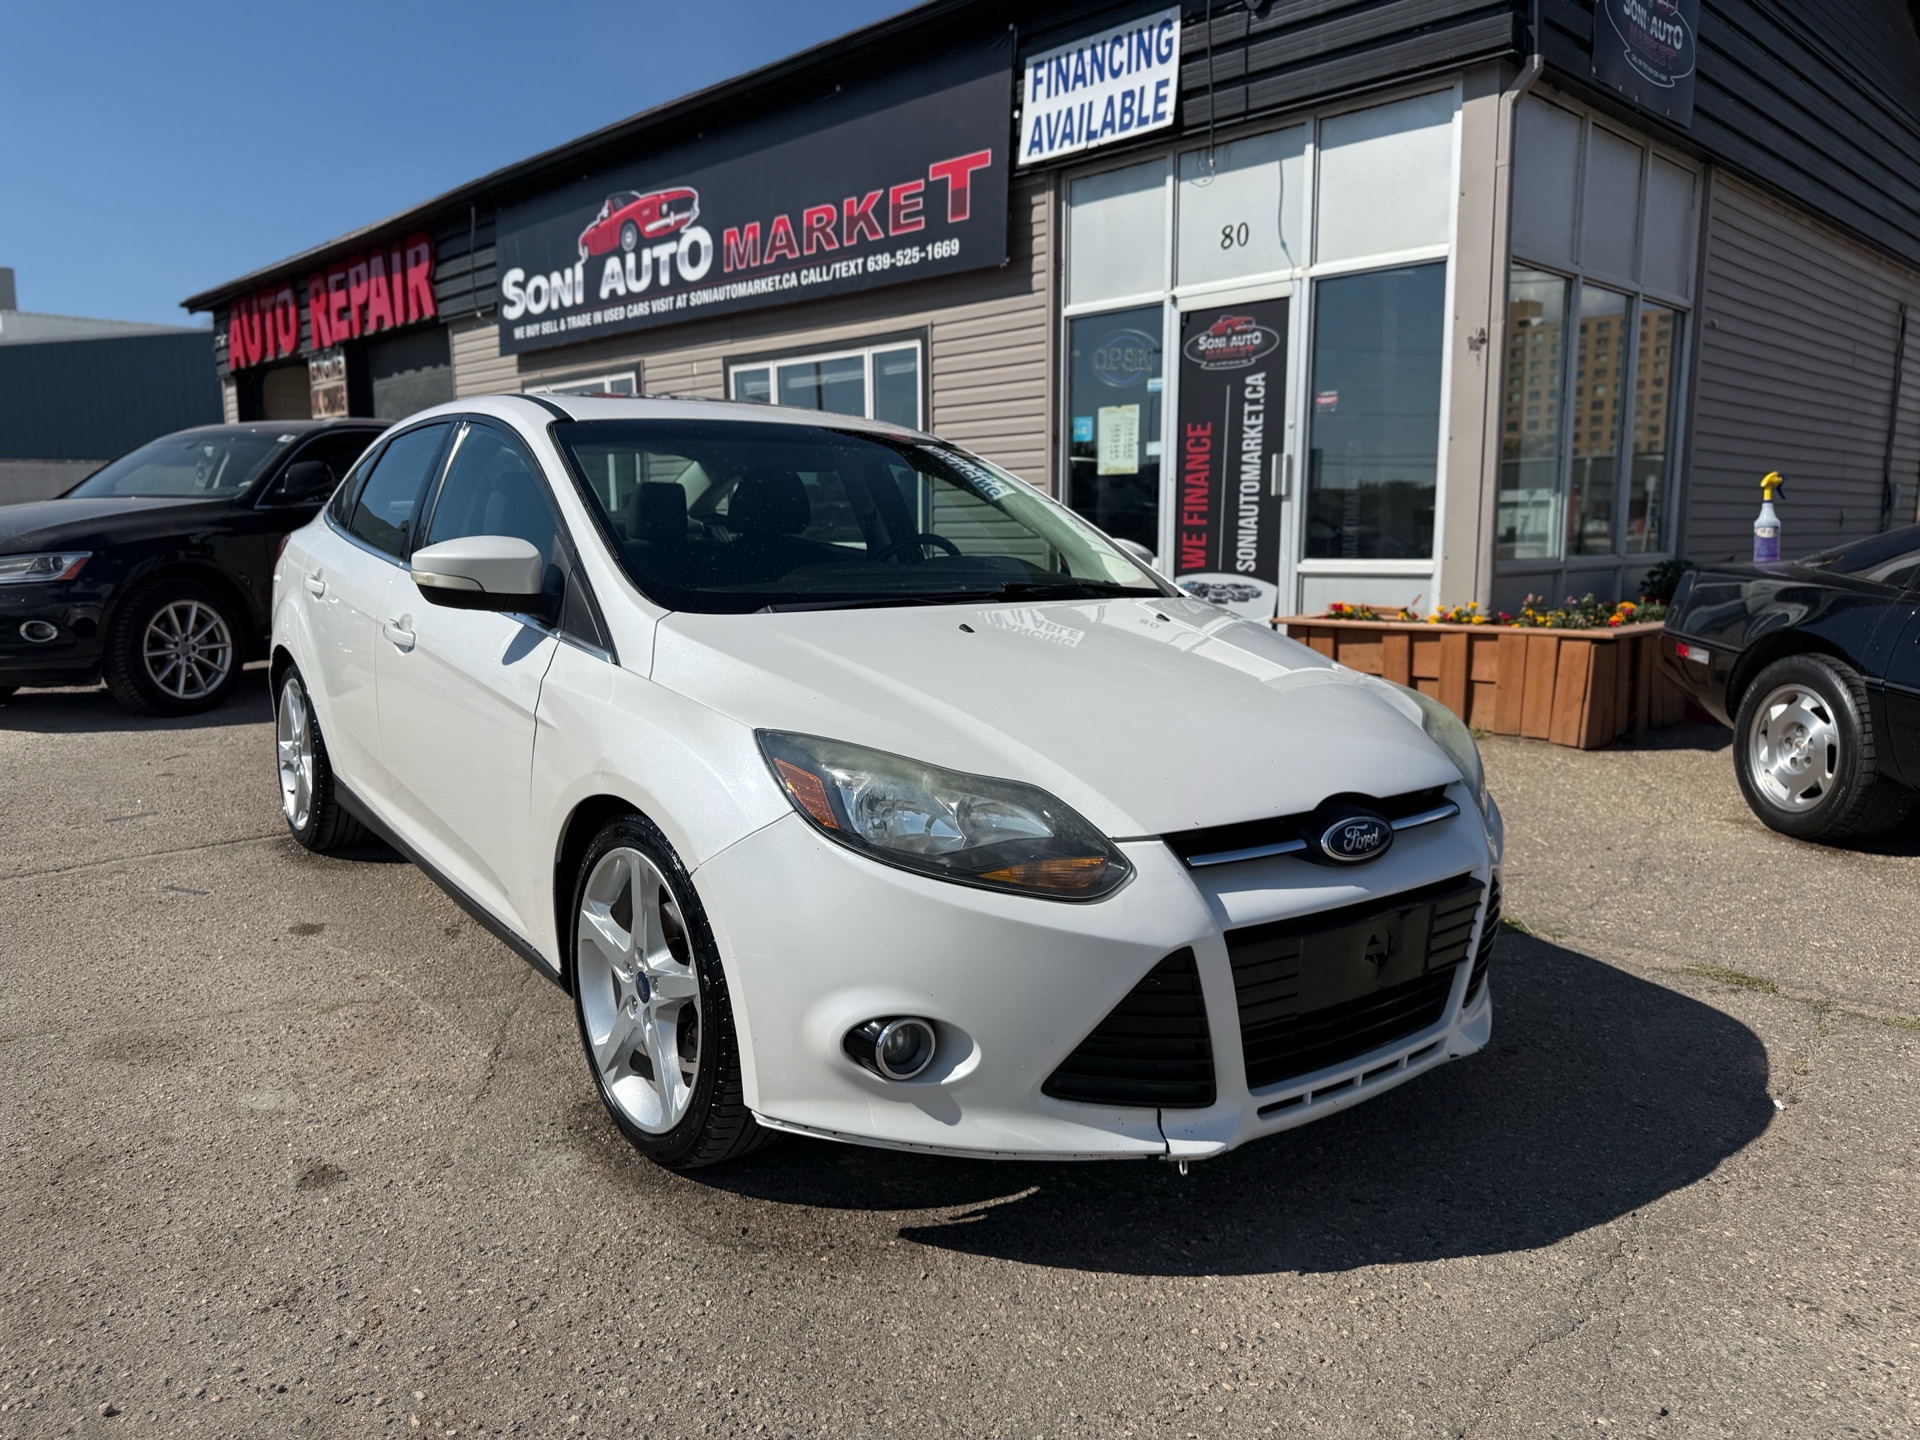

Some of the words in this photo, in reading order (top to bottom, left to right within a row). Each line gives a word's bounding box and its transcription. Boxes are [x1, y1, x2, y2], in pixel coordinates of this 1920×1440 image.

[1031, 18, 1174, 103] FINANCING
[1650, 15, 1683, 50] AUTO
[1026, 77, 1170, 157] AVAILABLE
[502, 261, 585, 320] SONI
[599, 225, 713, 300] AUTO
[723, 148, 992, 273] MARKET
[1220, 222, 1249, 250] 80
[229, 285, 299, 370] AUTO
[308, 233, 437, 349] REPAIR
[514, 326, 526, 340] WE
[526, 324, 541, 338] BUY
[541, 321, 558, 335] SELL
[559, 317, 566, 332] &
[567, 312, 592, 330] TRADE
[593, 310, 602, 324] IN
[603, 305, 625, 323] USED
[626, 301, 650, 319] CARS
[651, 295, 674, 314] VISIT
[675, 294, 688, 310] AT
[689, 271, 798, 307] SONIAUTOMARKET.CA
[800, 257, 864, 286] CALL/TEXT
[867, 237, 960, 273] 639-525-1669
[1198, 335, 1227, 351] SONI
[1229, 330, 1262, 348] AUTO
[1183, 422, 1212, 525] FINANCE
[1236, 371, 1267, 572] SONIAUTOMARKET.CA
[1181, 532, 1206, 569] WE
[1343, 823, 1380, 852] Ford
